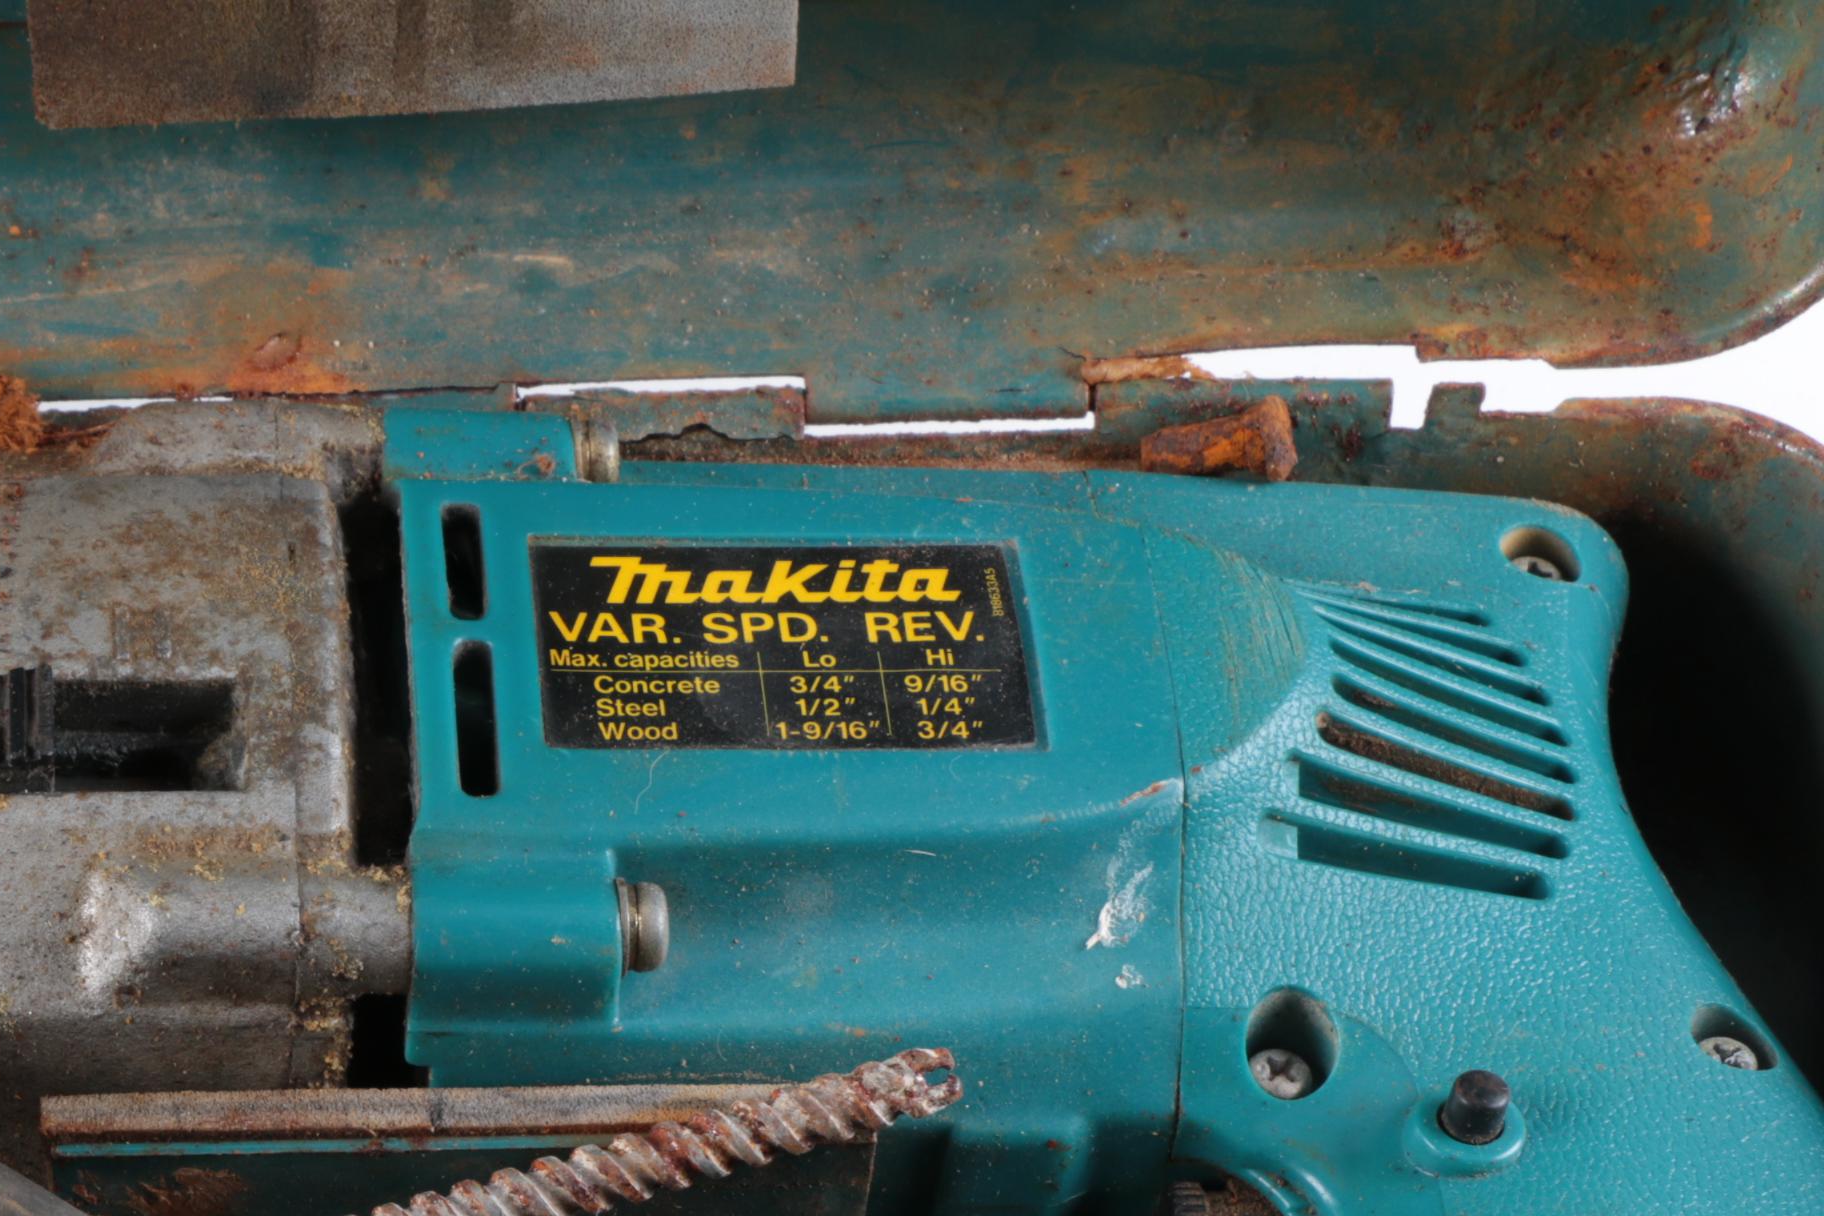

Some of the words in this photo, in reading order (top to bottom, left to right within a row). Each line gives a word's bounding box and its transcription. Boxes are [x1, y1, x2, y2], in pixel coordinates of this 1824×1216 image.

[589, 556, 962, 604] Makita
[548, 611, 682, 644] VAR.
[702, 612, 829, 644] SPD.
[864, 611, 985, 643] REV.
[549, 648, 608, 668] Max.
[614, 651, 740, 671] capacities
[801, 650, 838, 668] Lo
[926, 648, 955, 666] Hi
[593, 675, 721, 695] Concrete
[789, 675, 855, 694] 3/4"
[903, 674, 982, 694] 9/16"
[596, 698, 667, 718] Steel
[795, 697, 856, 717] 1/2"
[916, 697, 976, 716] 1/4"
[598, 722, 679, 741] Wood
[775, 720, 880, 741] 1-9/16"
[917, 720, 984, 740] 3/4"
